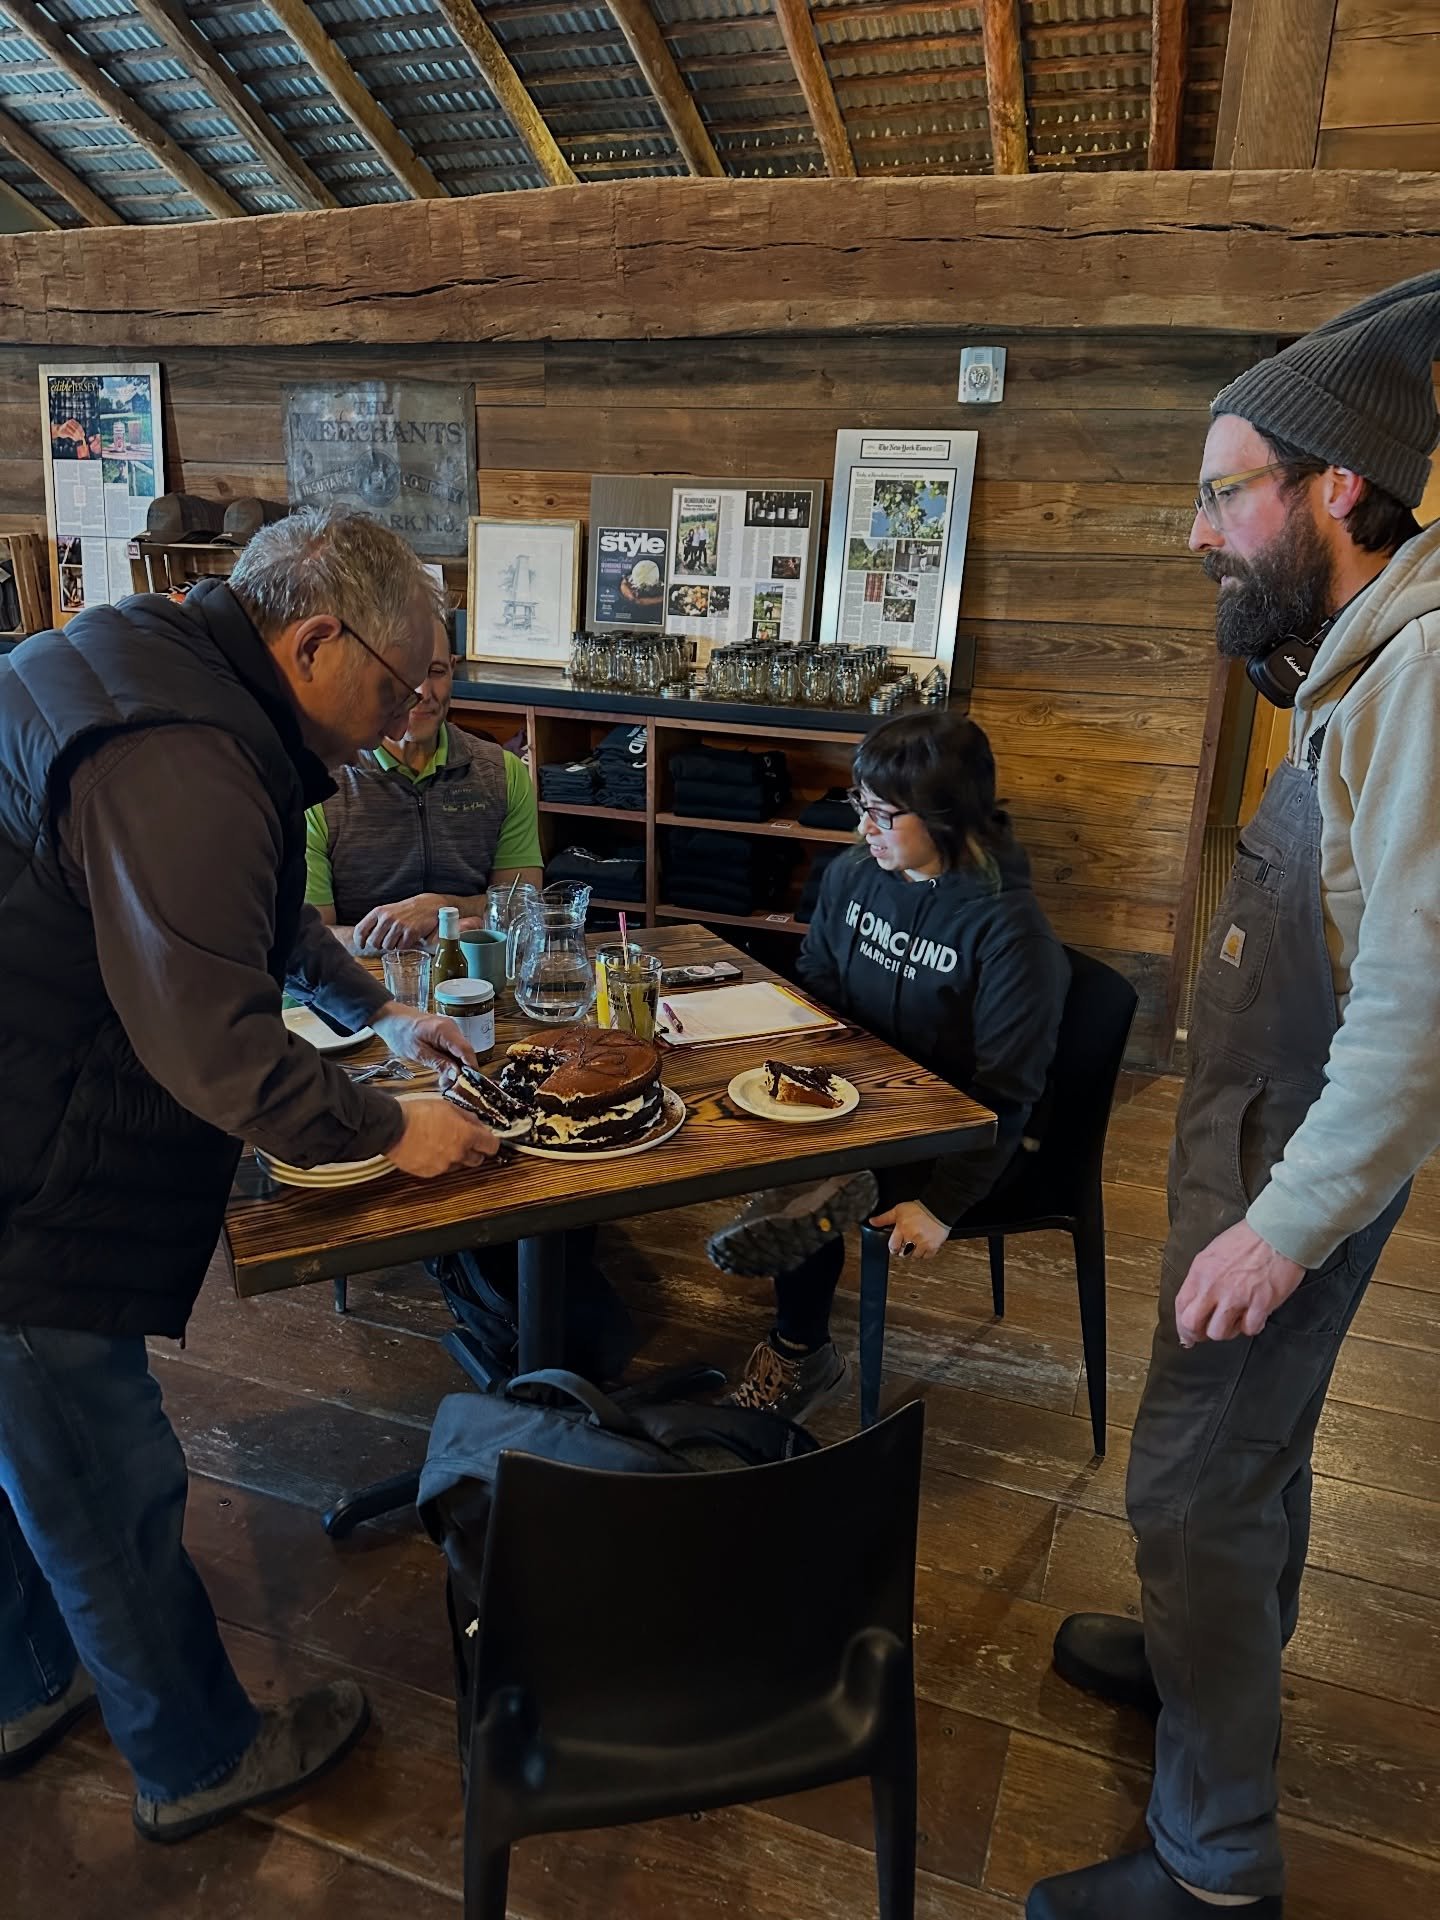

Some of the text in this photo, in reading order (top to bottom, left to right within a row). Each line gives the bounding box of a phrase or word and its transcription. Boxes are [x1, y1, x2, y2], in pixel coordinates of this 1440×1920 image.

[878, 443, 889, 451] The
[901, 444, 915, 453] York
[600, 531, 665, 557] style
